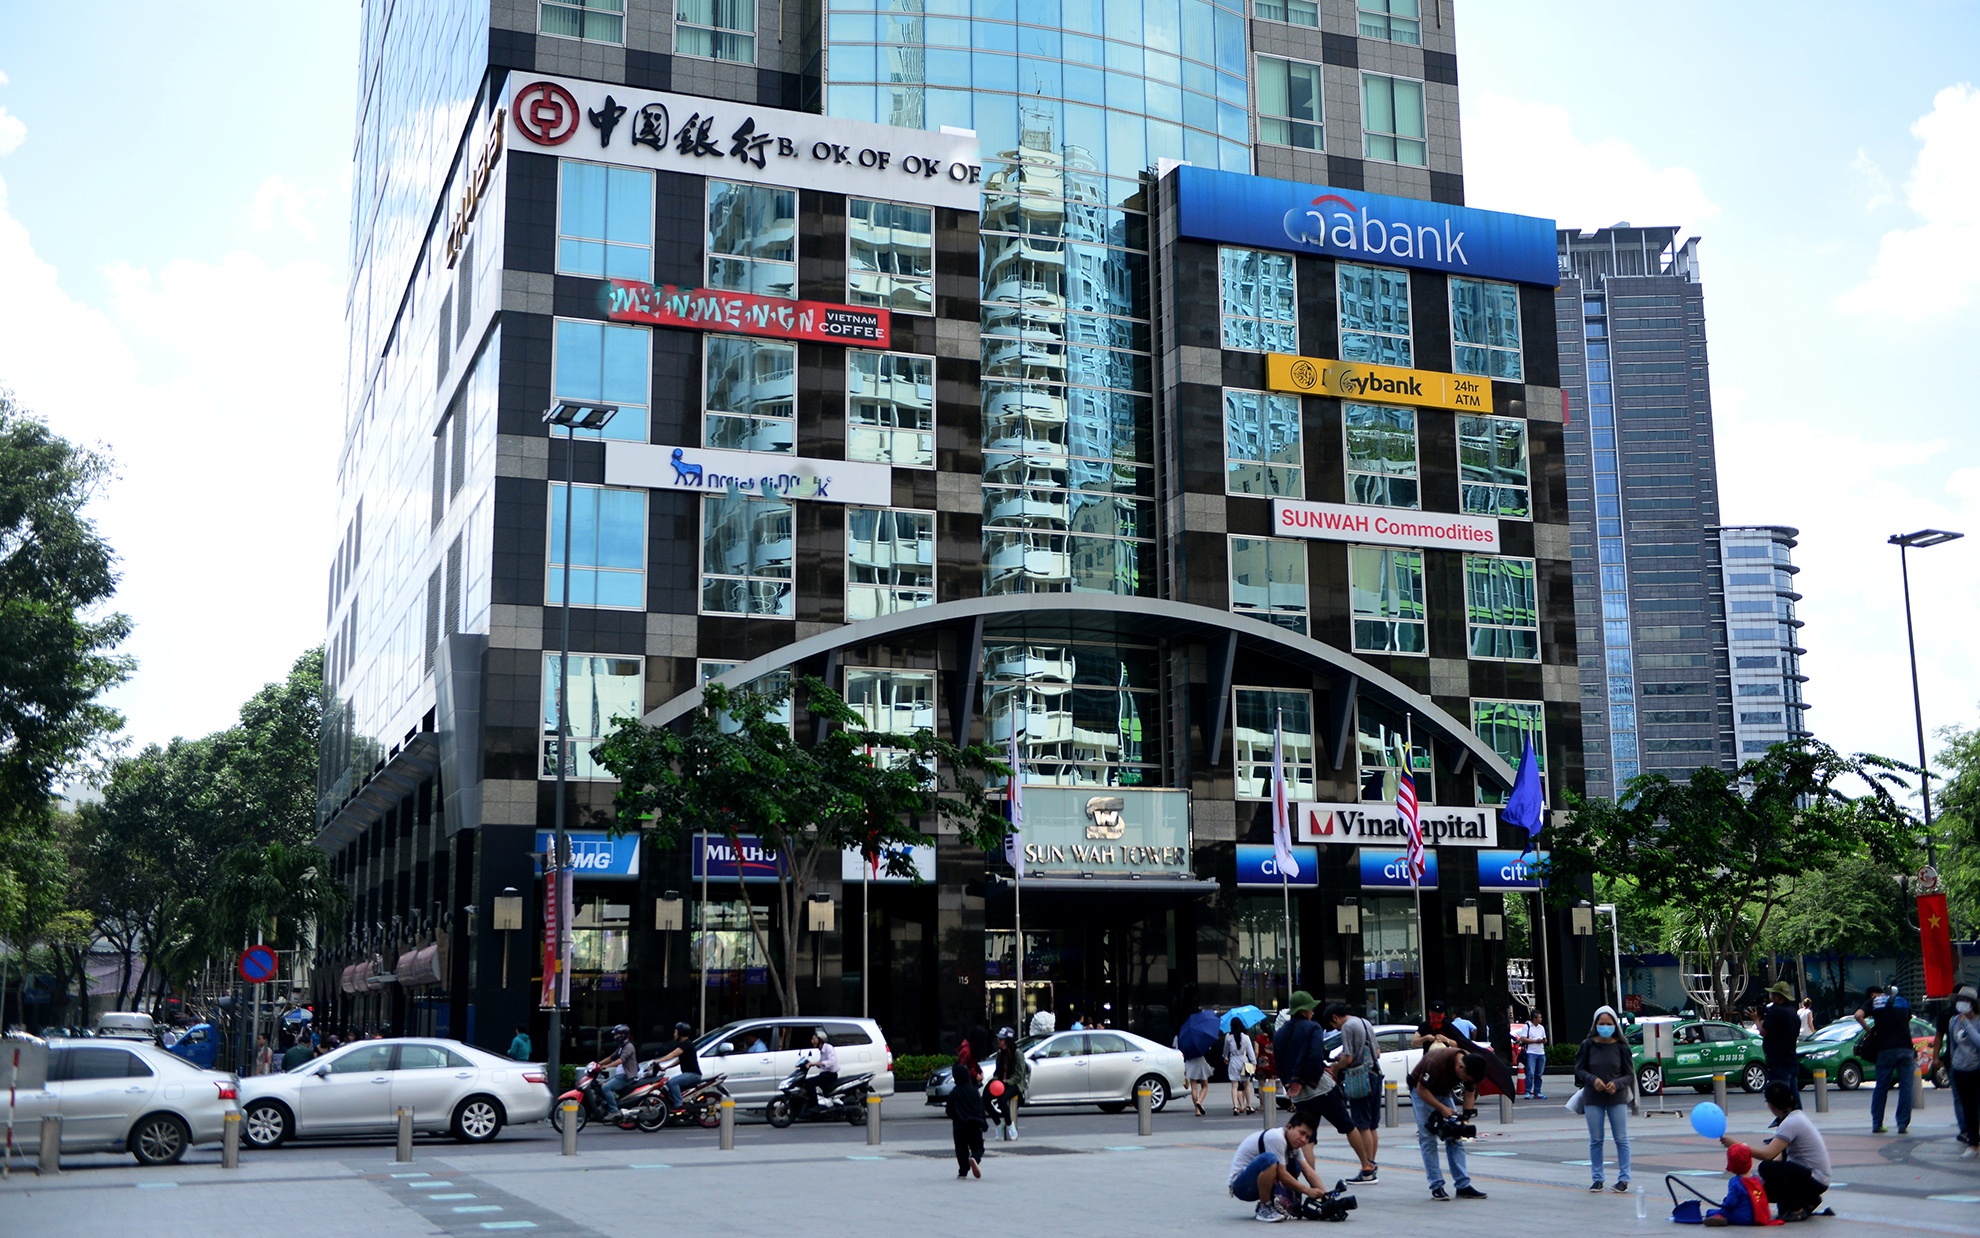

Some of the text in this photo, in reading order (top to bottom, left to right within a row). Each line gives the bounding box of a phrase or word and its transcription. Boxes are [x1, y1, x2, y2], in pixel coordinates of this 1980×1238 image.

[588, 94, 774, 170] 中國銀行
[826, 312, 877, 325] VIETNAM
[818, 322, 885, 338] COFFEE
[1454, 380, 1479, 393] 24hr
[1455, 394, 1480, 406] ATM
[1281, 508, 1494, 543] SUNWAH Commodities
[1025, 844, 1185, 865] SUN WAH TOWER
[1384, 860, 1409, 879] cit
